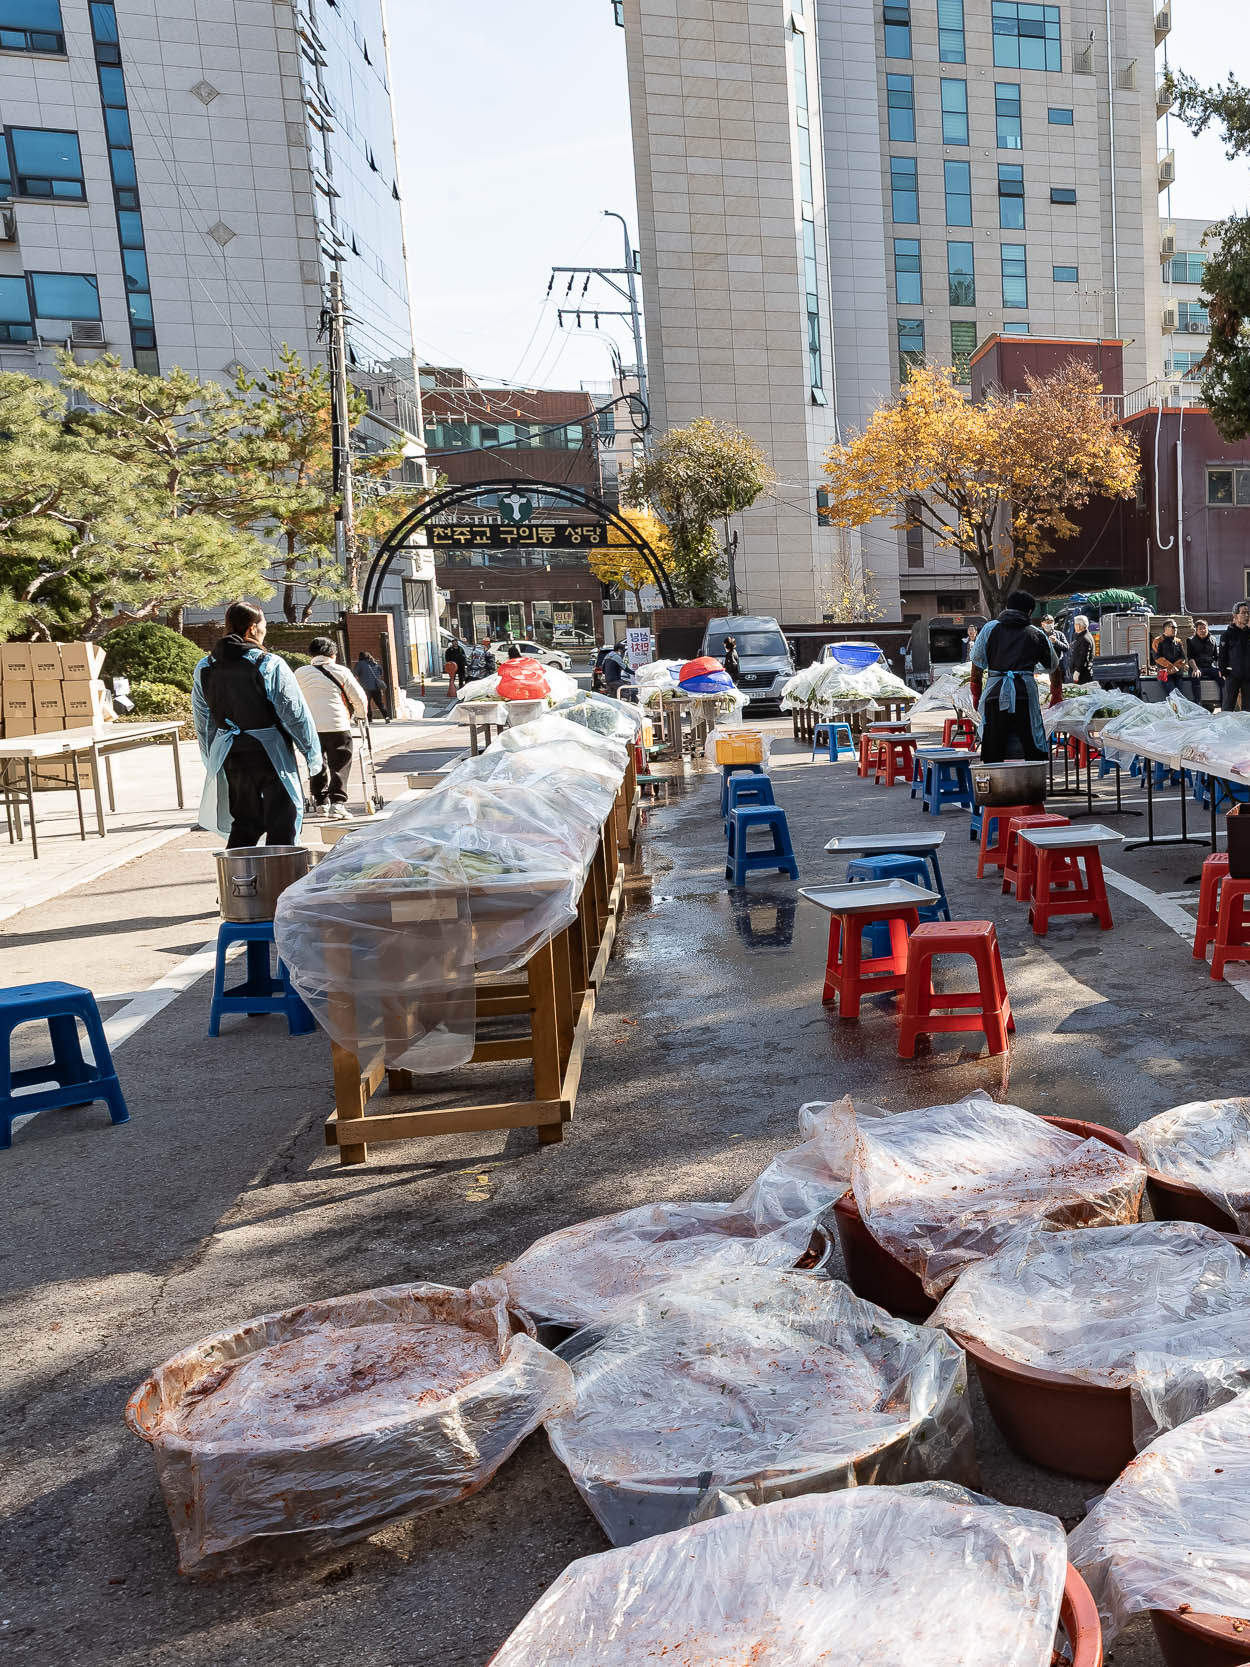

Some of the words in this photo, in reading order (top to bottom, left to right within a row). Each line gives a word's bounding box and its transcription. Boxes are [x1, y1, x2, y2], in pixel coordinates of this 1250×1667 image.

[432, 526, 492, 544] 천주교
[499, 526, 556, 544] 구의동
[564, 526, 602, 544] 성당
